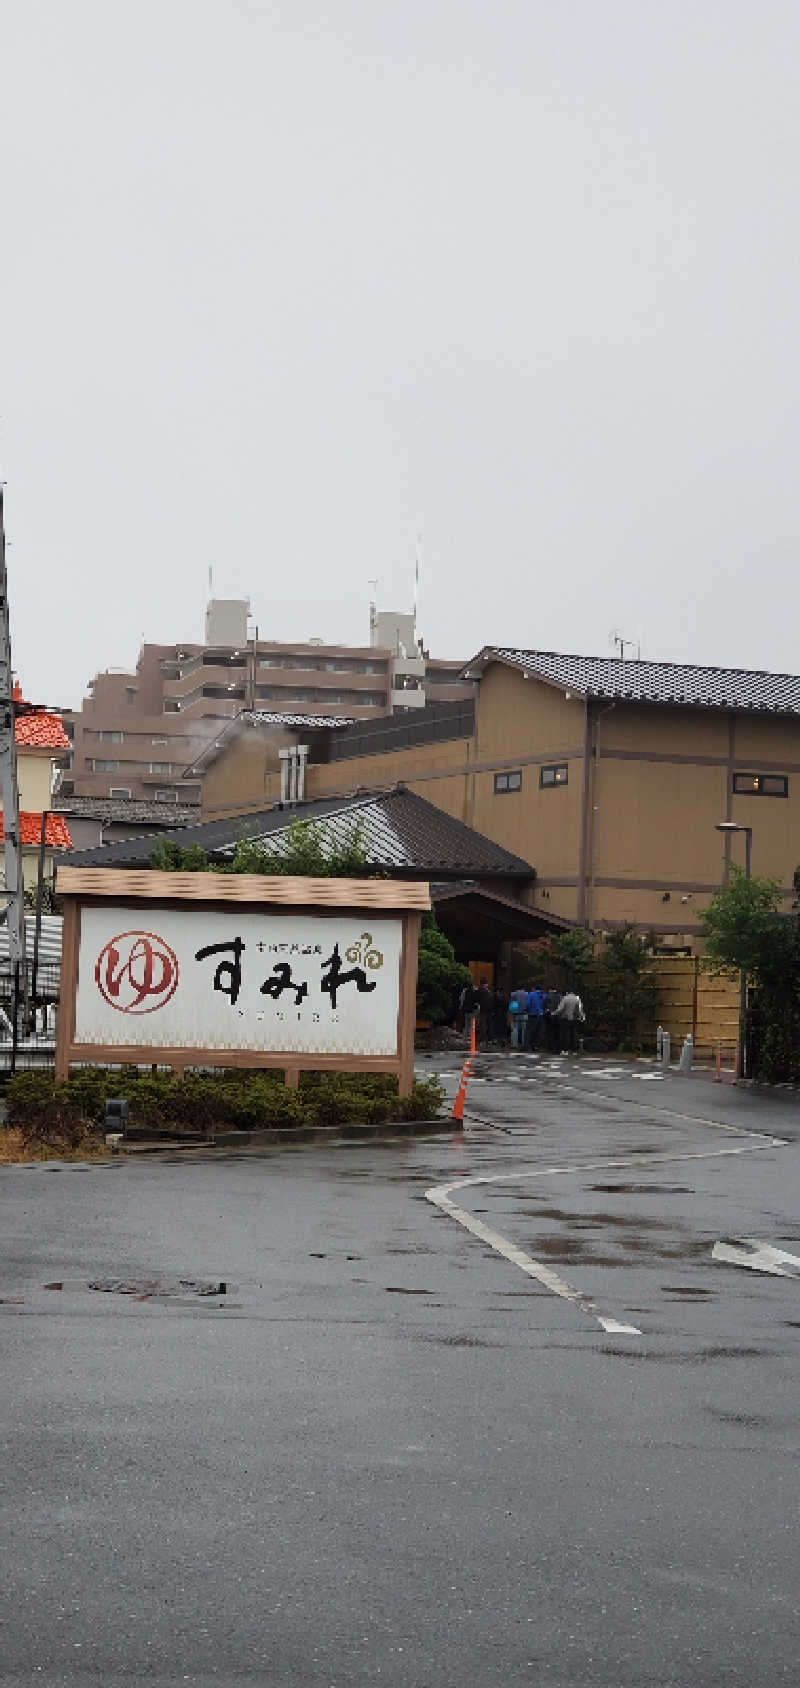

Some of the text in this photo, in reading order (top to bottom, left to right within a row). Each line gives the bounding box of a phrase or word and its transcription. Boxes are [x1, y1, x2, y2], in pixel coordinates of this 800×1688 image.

[104, 936, 173, 1010] ゆ
[195, 937, 378, 1010] すみれ
